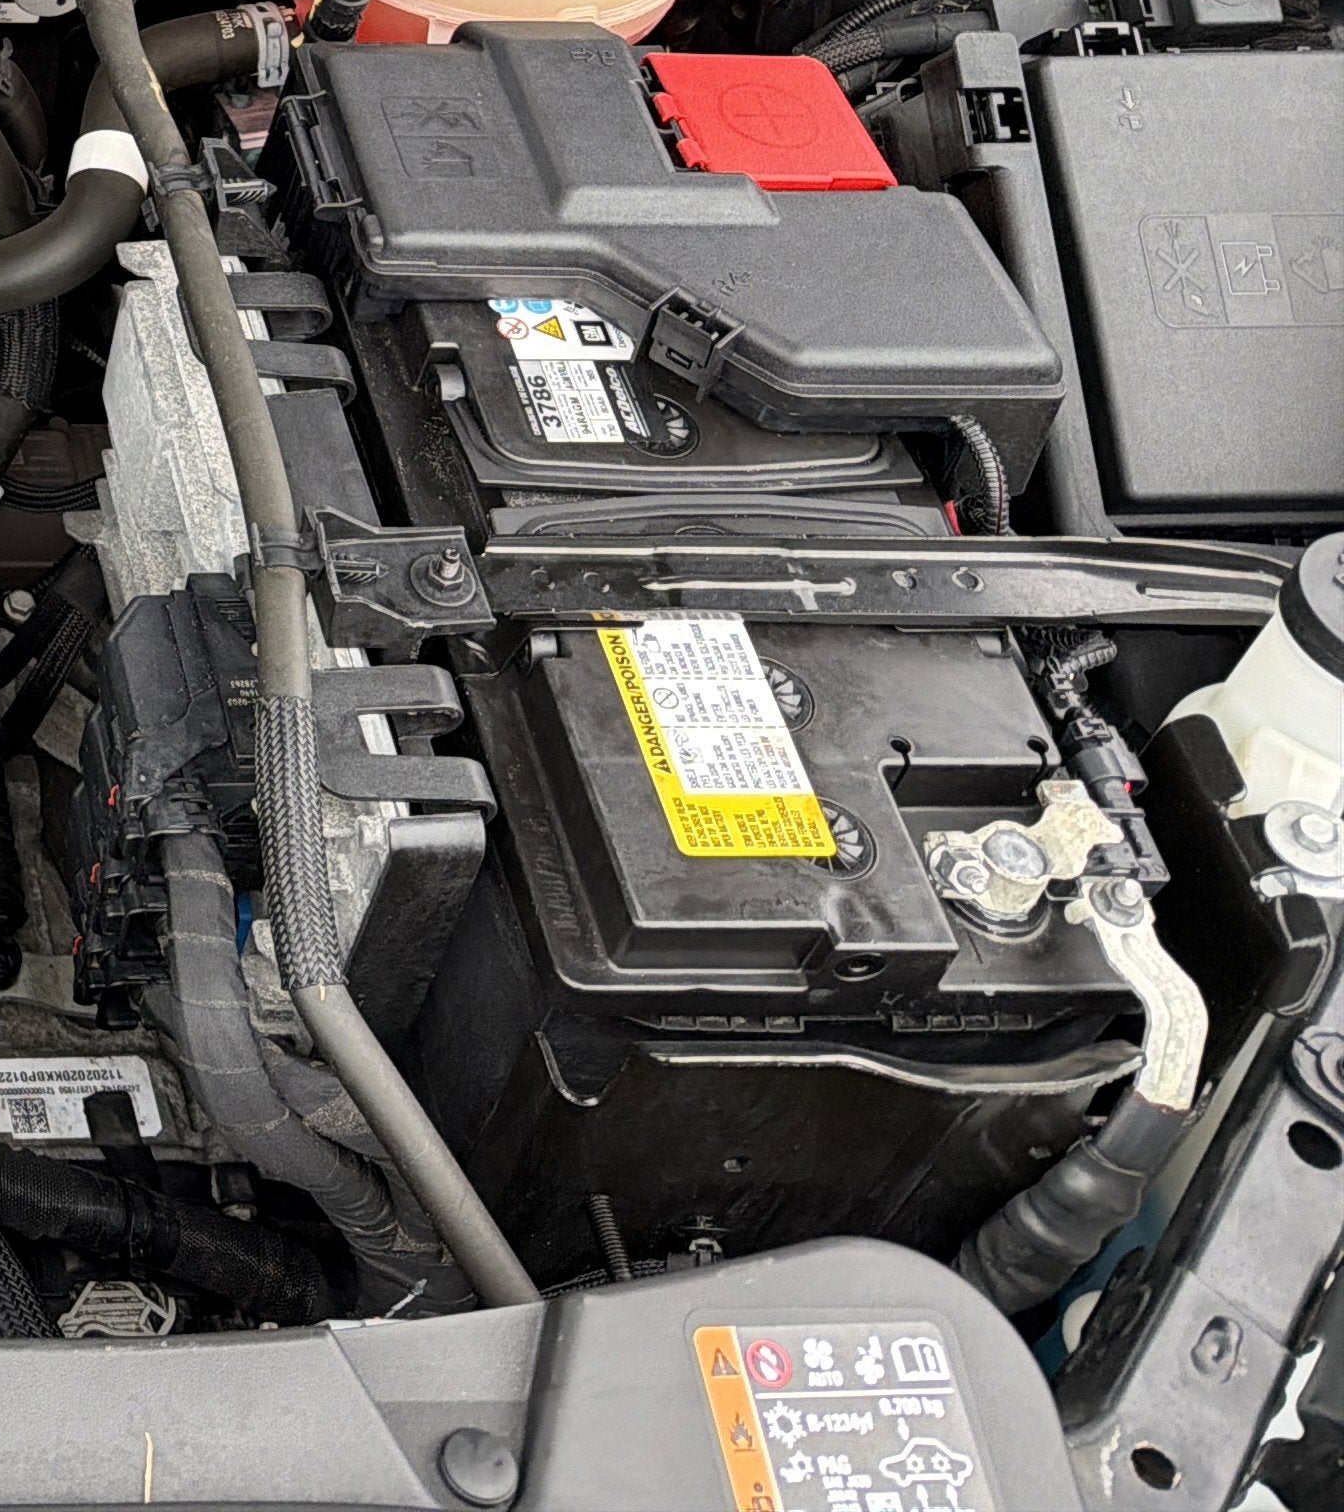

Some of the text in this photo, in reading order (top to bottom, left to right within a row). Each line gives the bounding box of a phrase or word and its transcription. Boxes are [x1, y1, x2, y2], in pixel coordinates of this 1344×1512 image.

[581, 324, 607, 342] GM
[528, 375, 562, 429] 3786
[606, 367, 641, 435] ACDelco
[606, 634, 665, 758] DANGER/POISON
